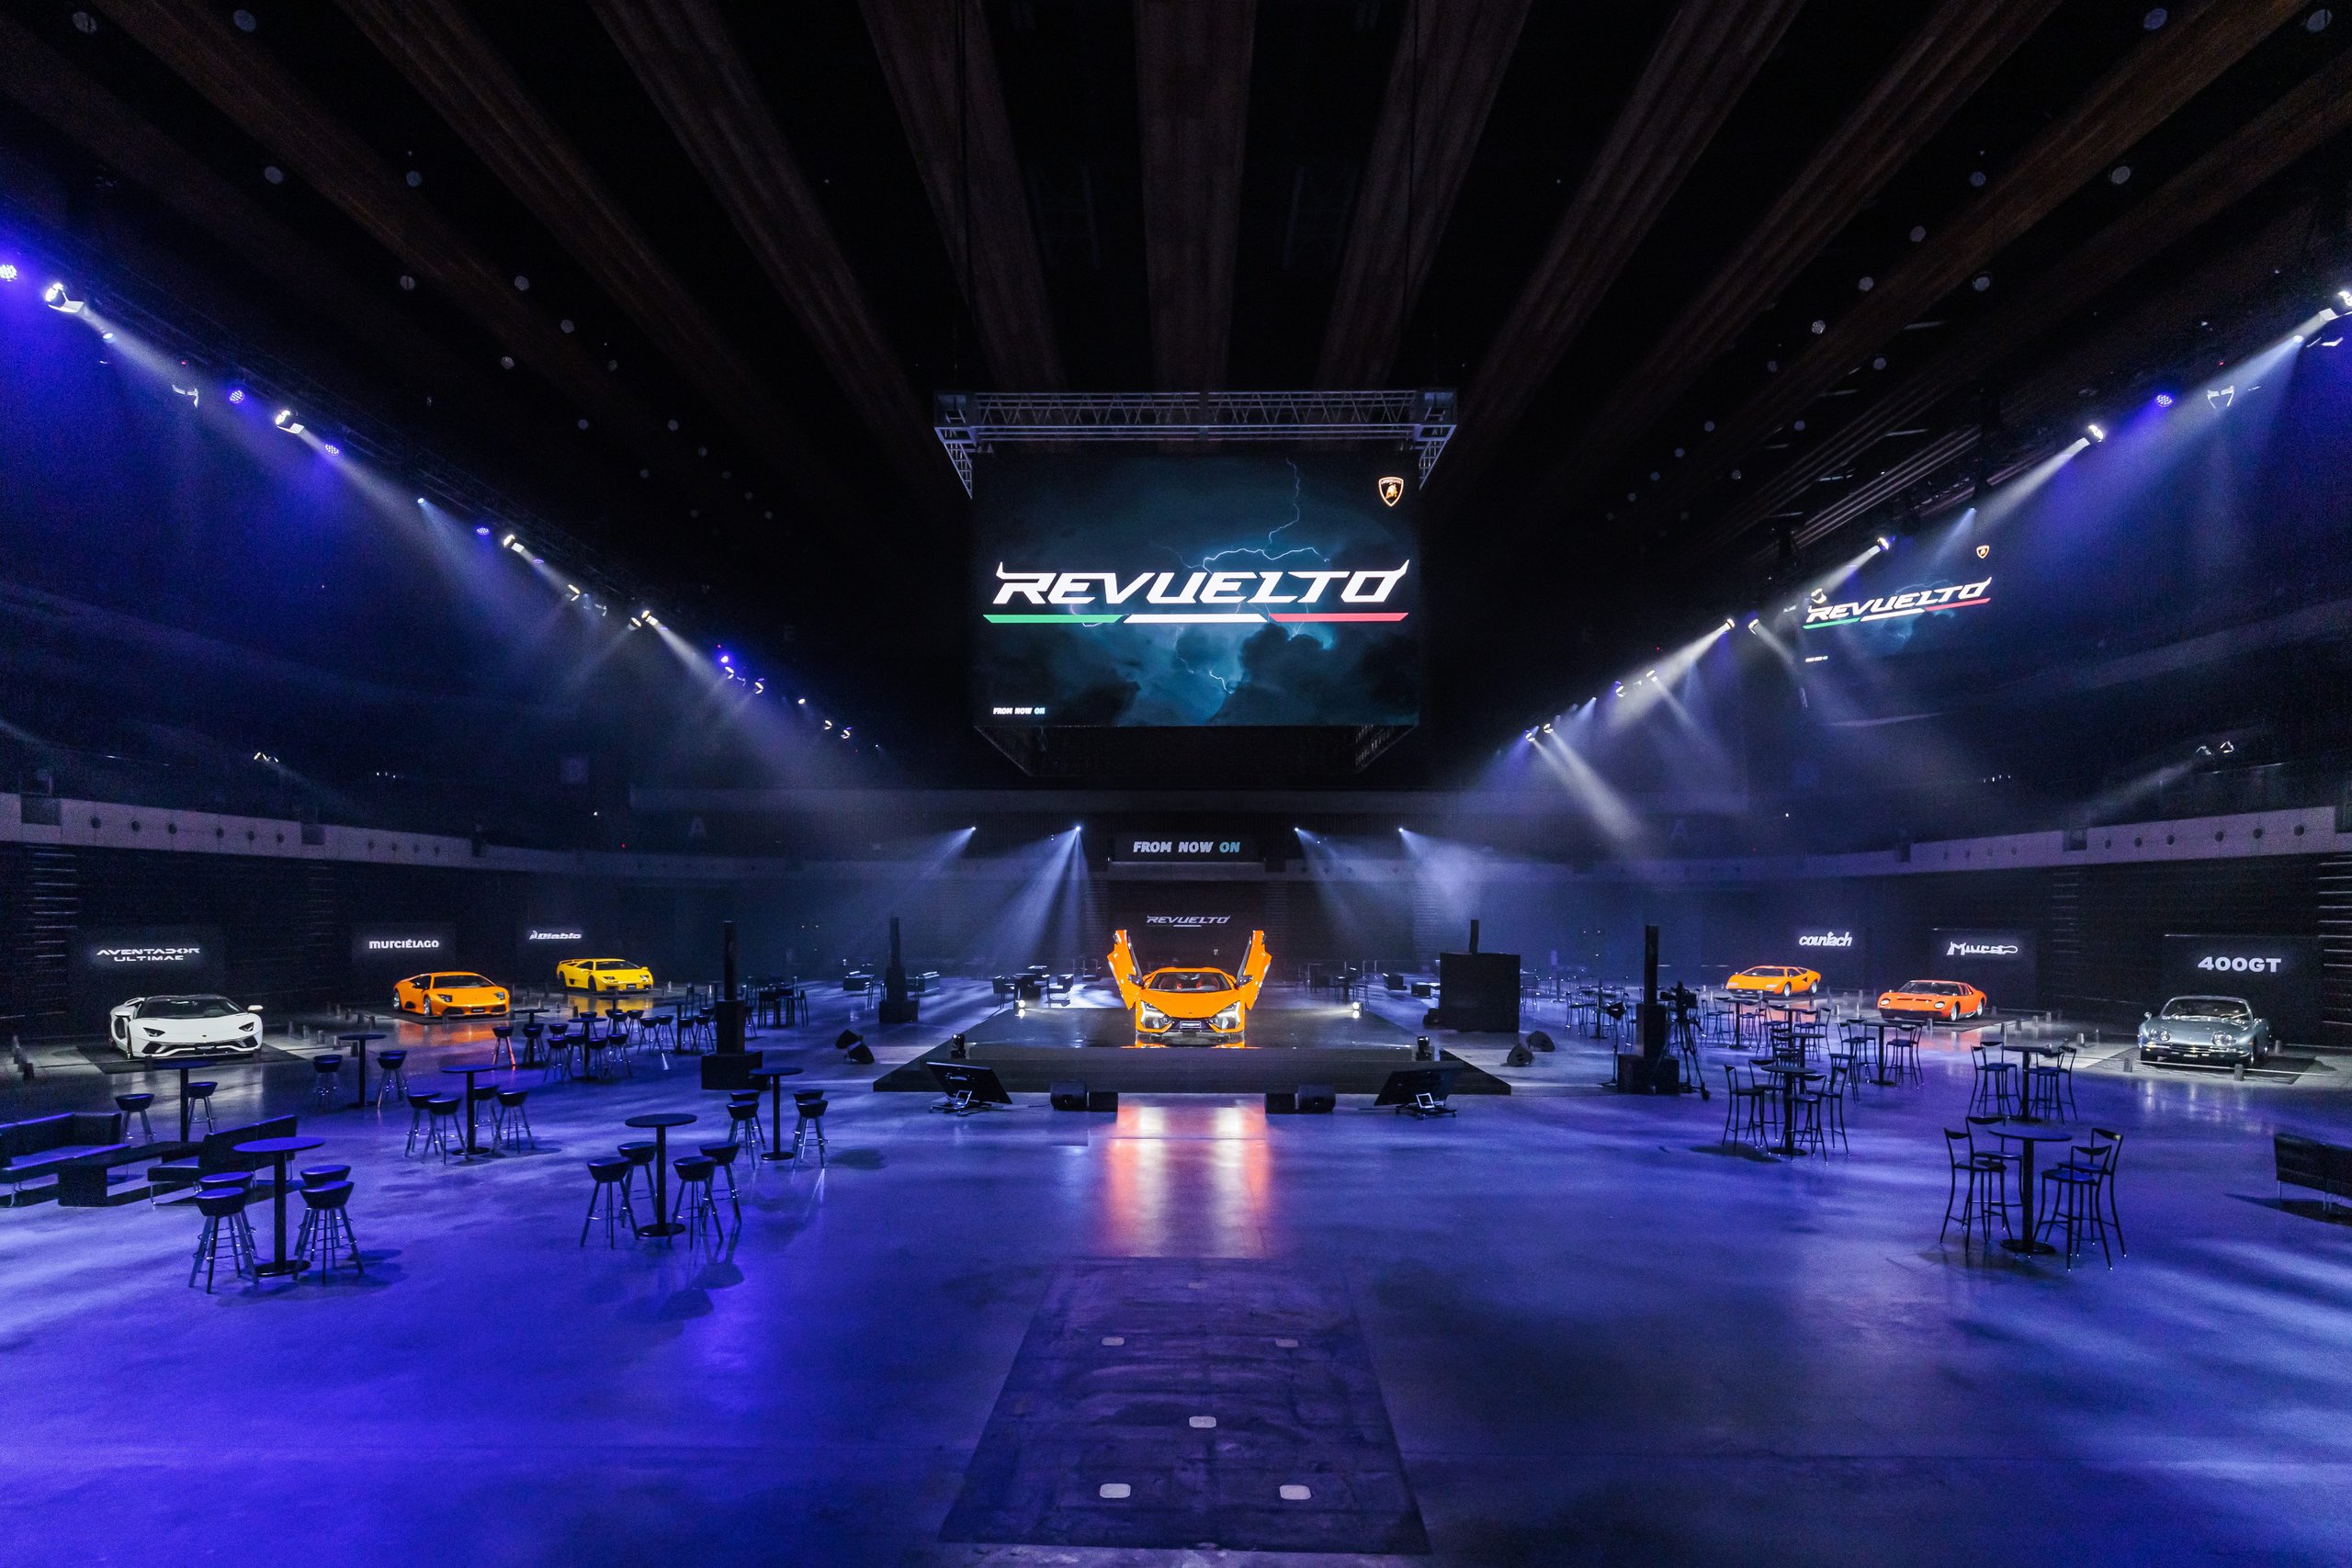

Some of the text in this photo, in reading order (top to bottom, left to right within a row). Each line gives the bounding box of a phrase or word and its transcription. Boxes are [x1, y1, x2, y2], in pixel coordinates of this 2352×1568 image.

[993, 559, 1410, 604] REVUELTO
[1806, 577, 1993, 623] REVUELTO
[992, 706, 1046, 715] FROM NOW ON
[1133, 840, 1240, 853] FROM NOW ON
[1146, 915, 1231, 924] REVUELTO
[2197, 956, 2282, 973] 400GT
